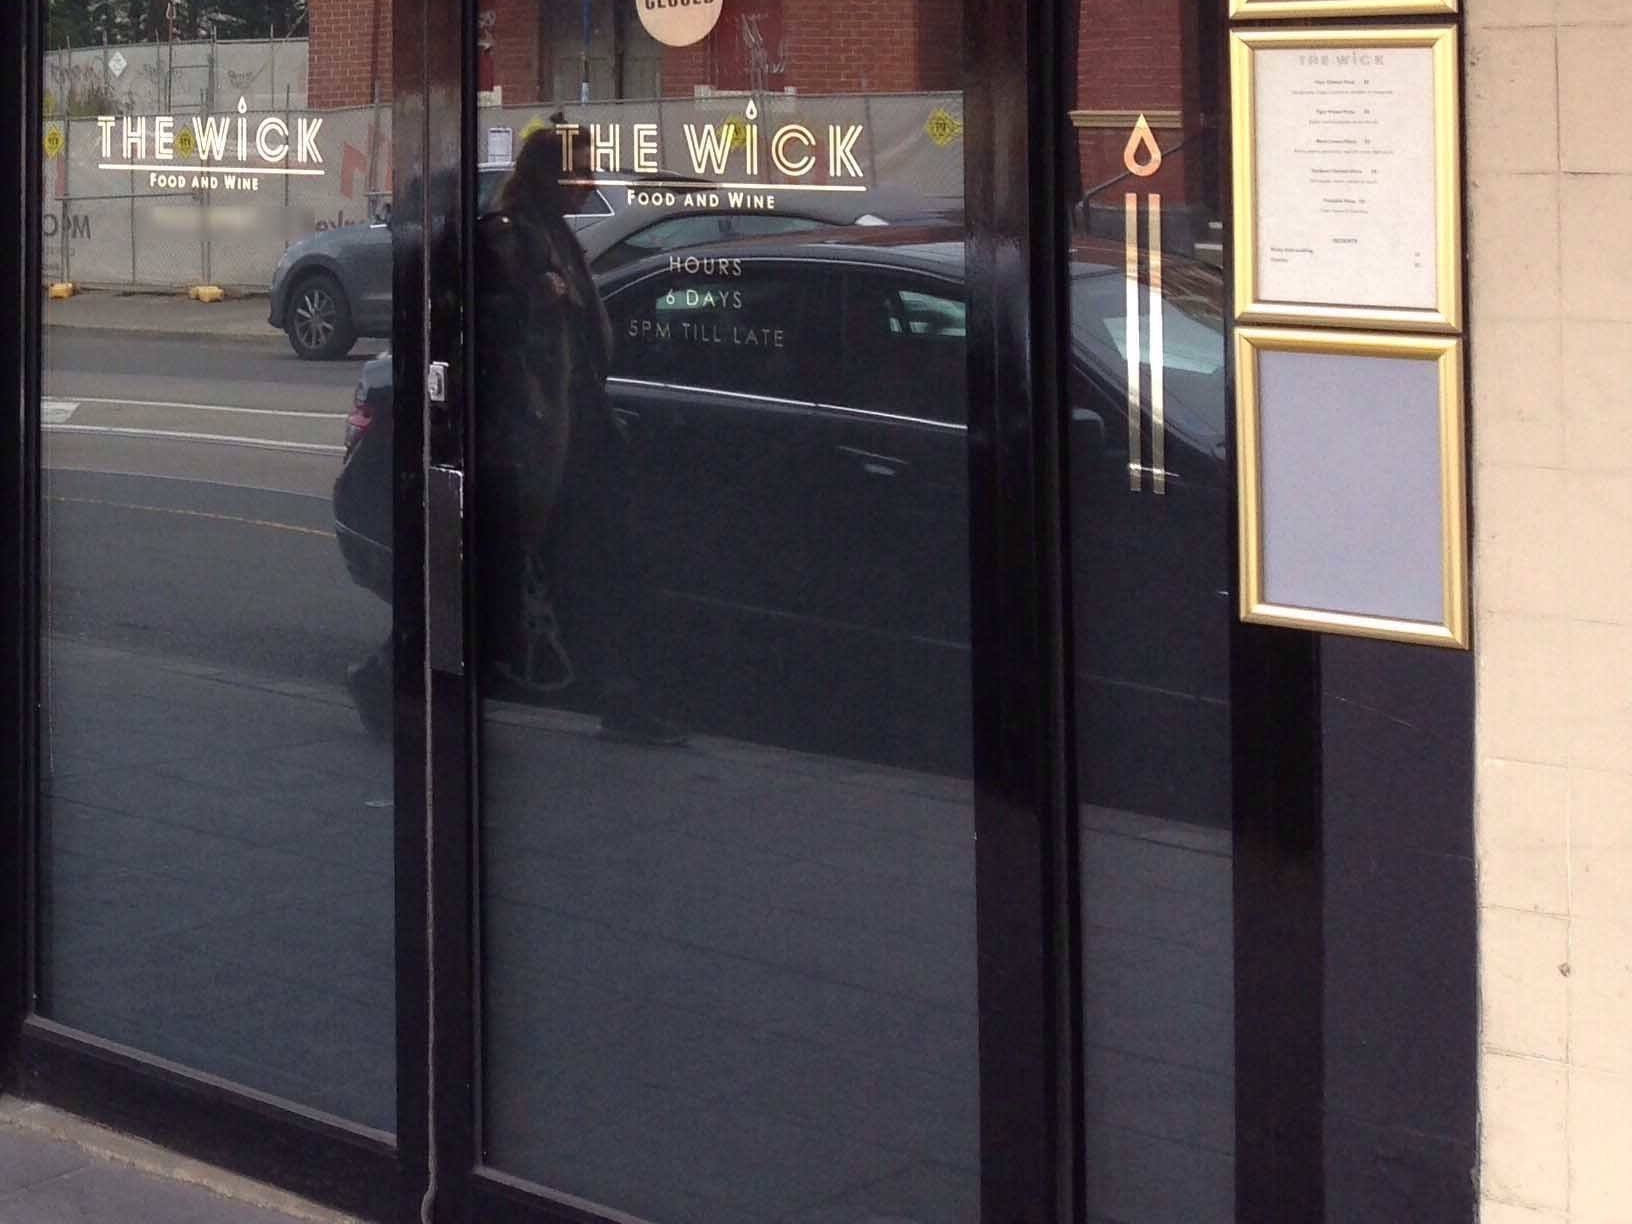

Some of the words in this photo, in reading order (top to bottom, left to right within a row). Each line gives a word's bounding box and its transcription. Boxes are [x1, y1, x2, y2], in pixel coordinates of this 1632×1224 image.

[97, 116, 174, 160] THE
[556, 124, 658, 173] THE
[192, 175, 218, 189] AND
[684, 193, 720, 209] AND
[669, 255, 743, 276] HOURS
[666, 289, 675, 306] 6
[686, 289, 743, 309] DAYS
[628, 319, 671, 339] 5PM
[682, 322, 721, 343] TILL
[733, 328, 785, 348] LATE
